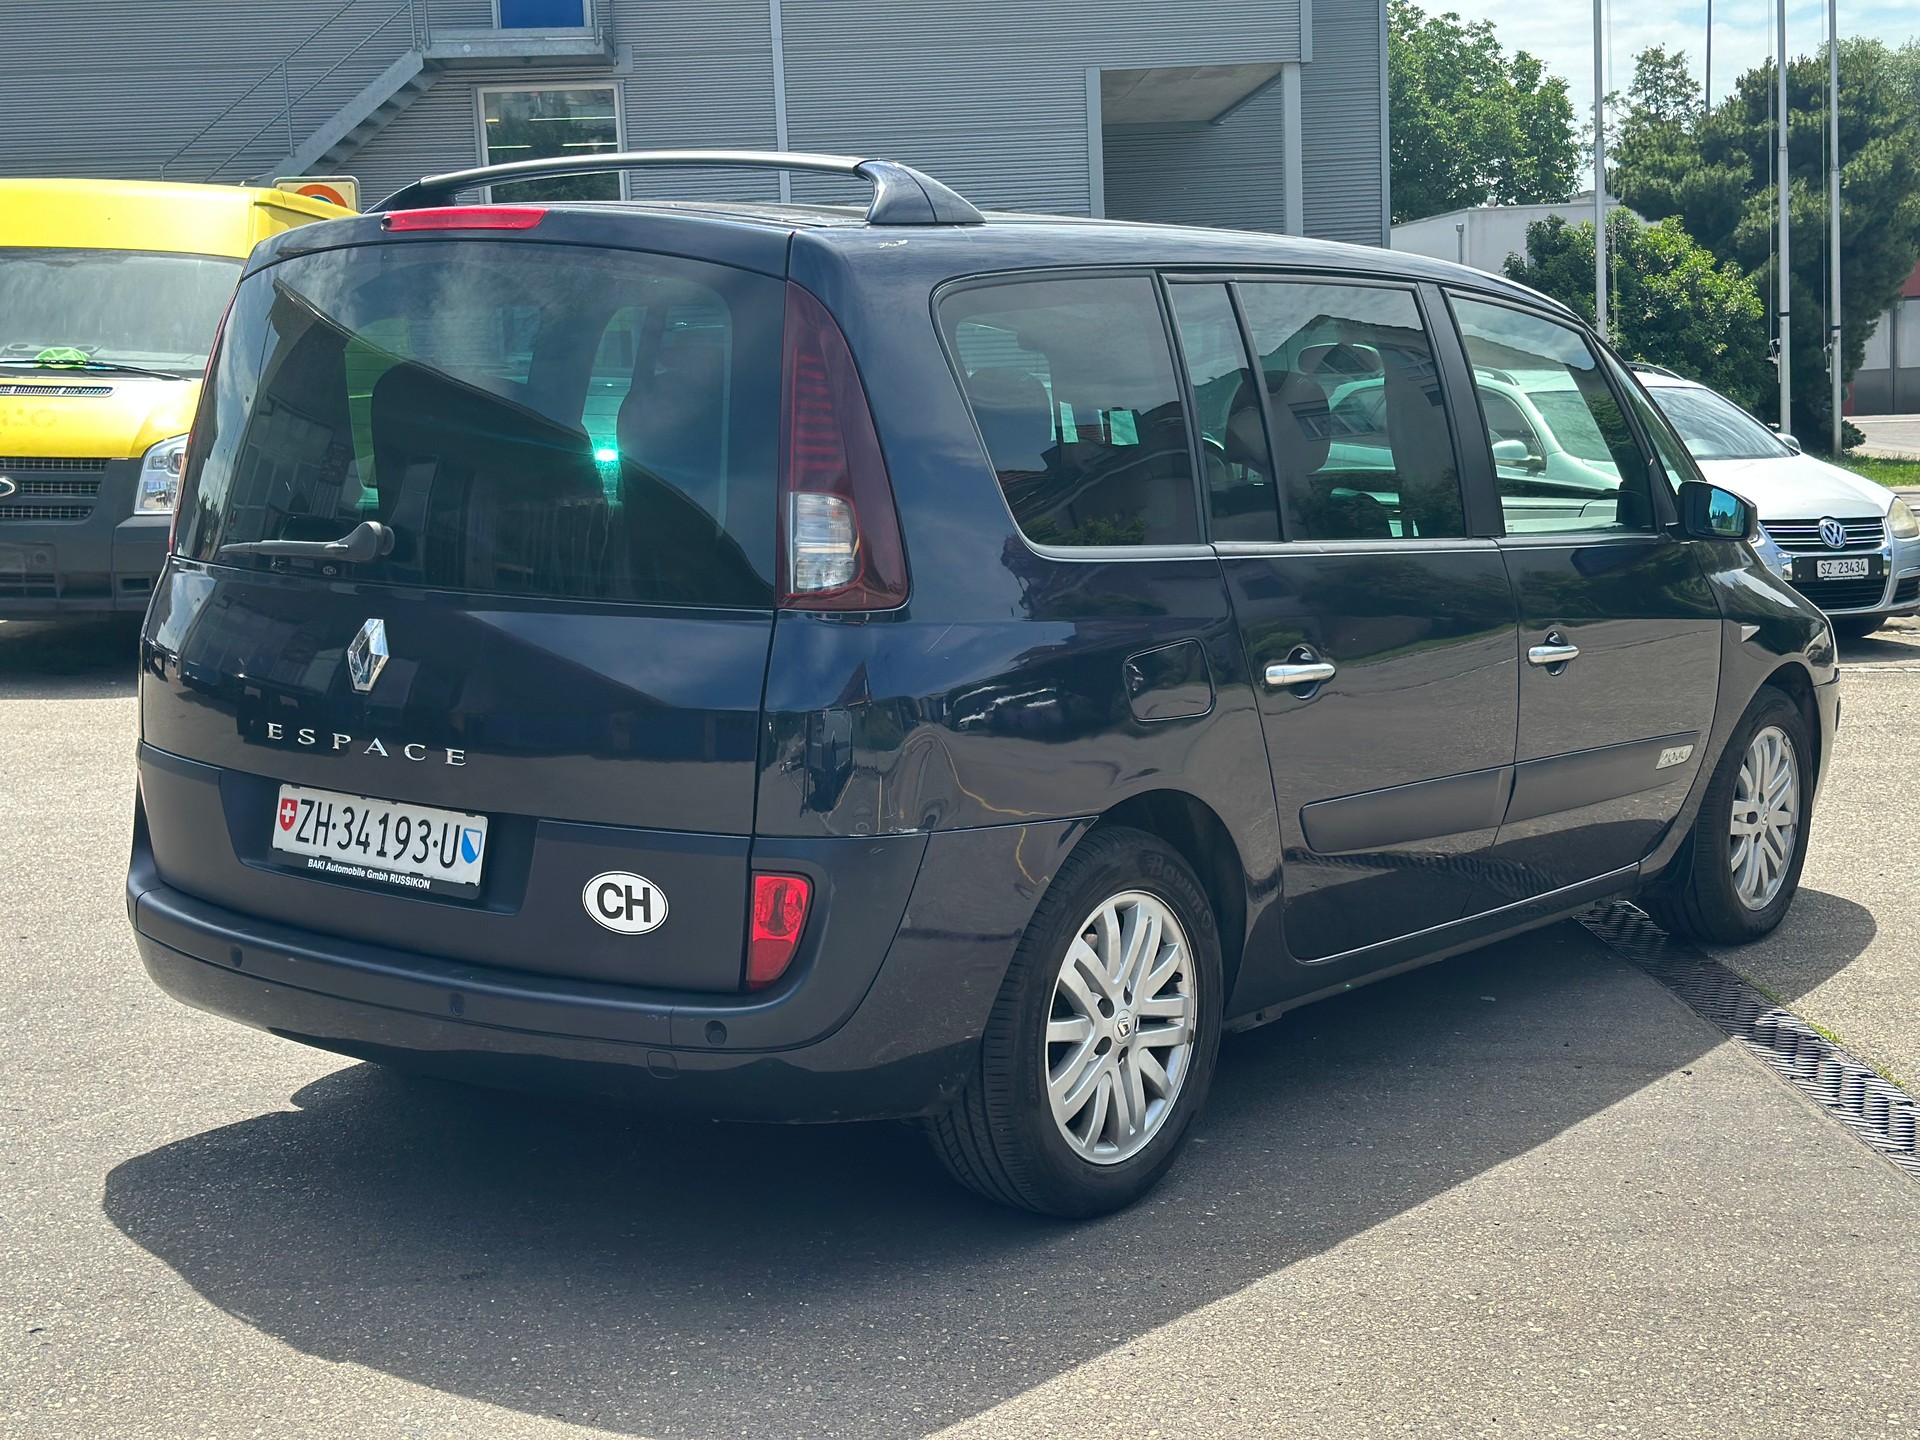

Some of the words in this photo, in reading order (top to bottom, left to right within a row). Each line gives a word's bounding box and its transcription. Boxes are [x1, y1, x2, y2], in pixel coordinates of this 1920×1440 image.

[267, 722, 466, 766] ESPACE
[307, 858, 325, 870] BAKI
[325, 862, 366, 878] Automobile
[366, 869, 389, 881] Gmbh
[389, 873, 431, 889] RUSSIKON
[597, 882, 652, 923] CH
